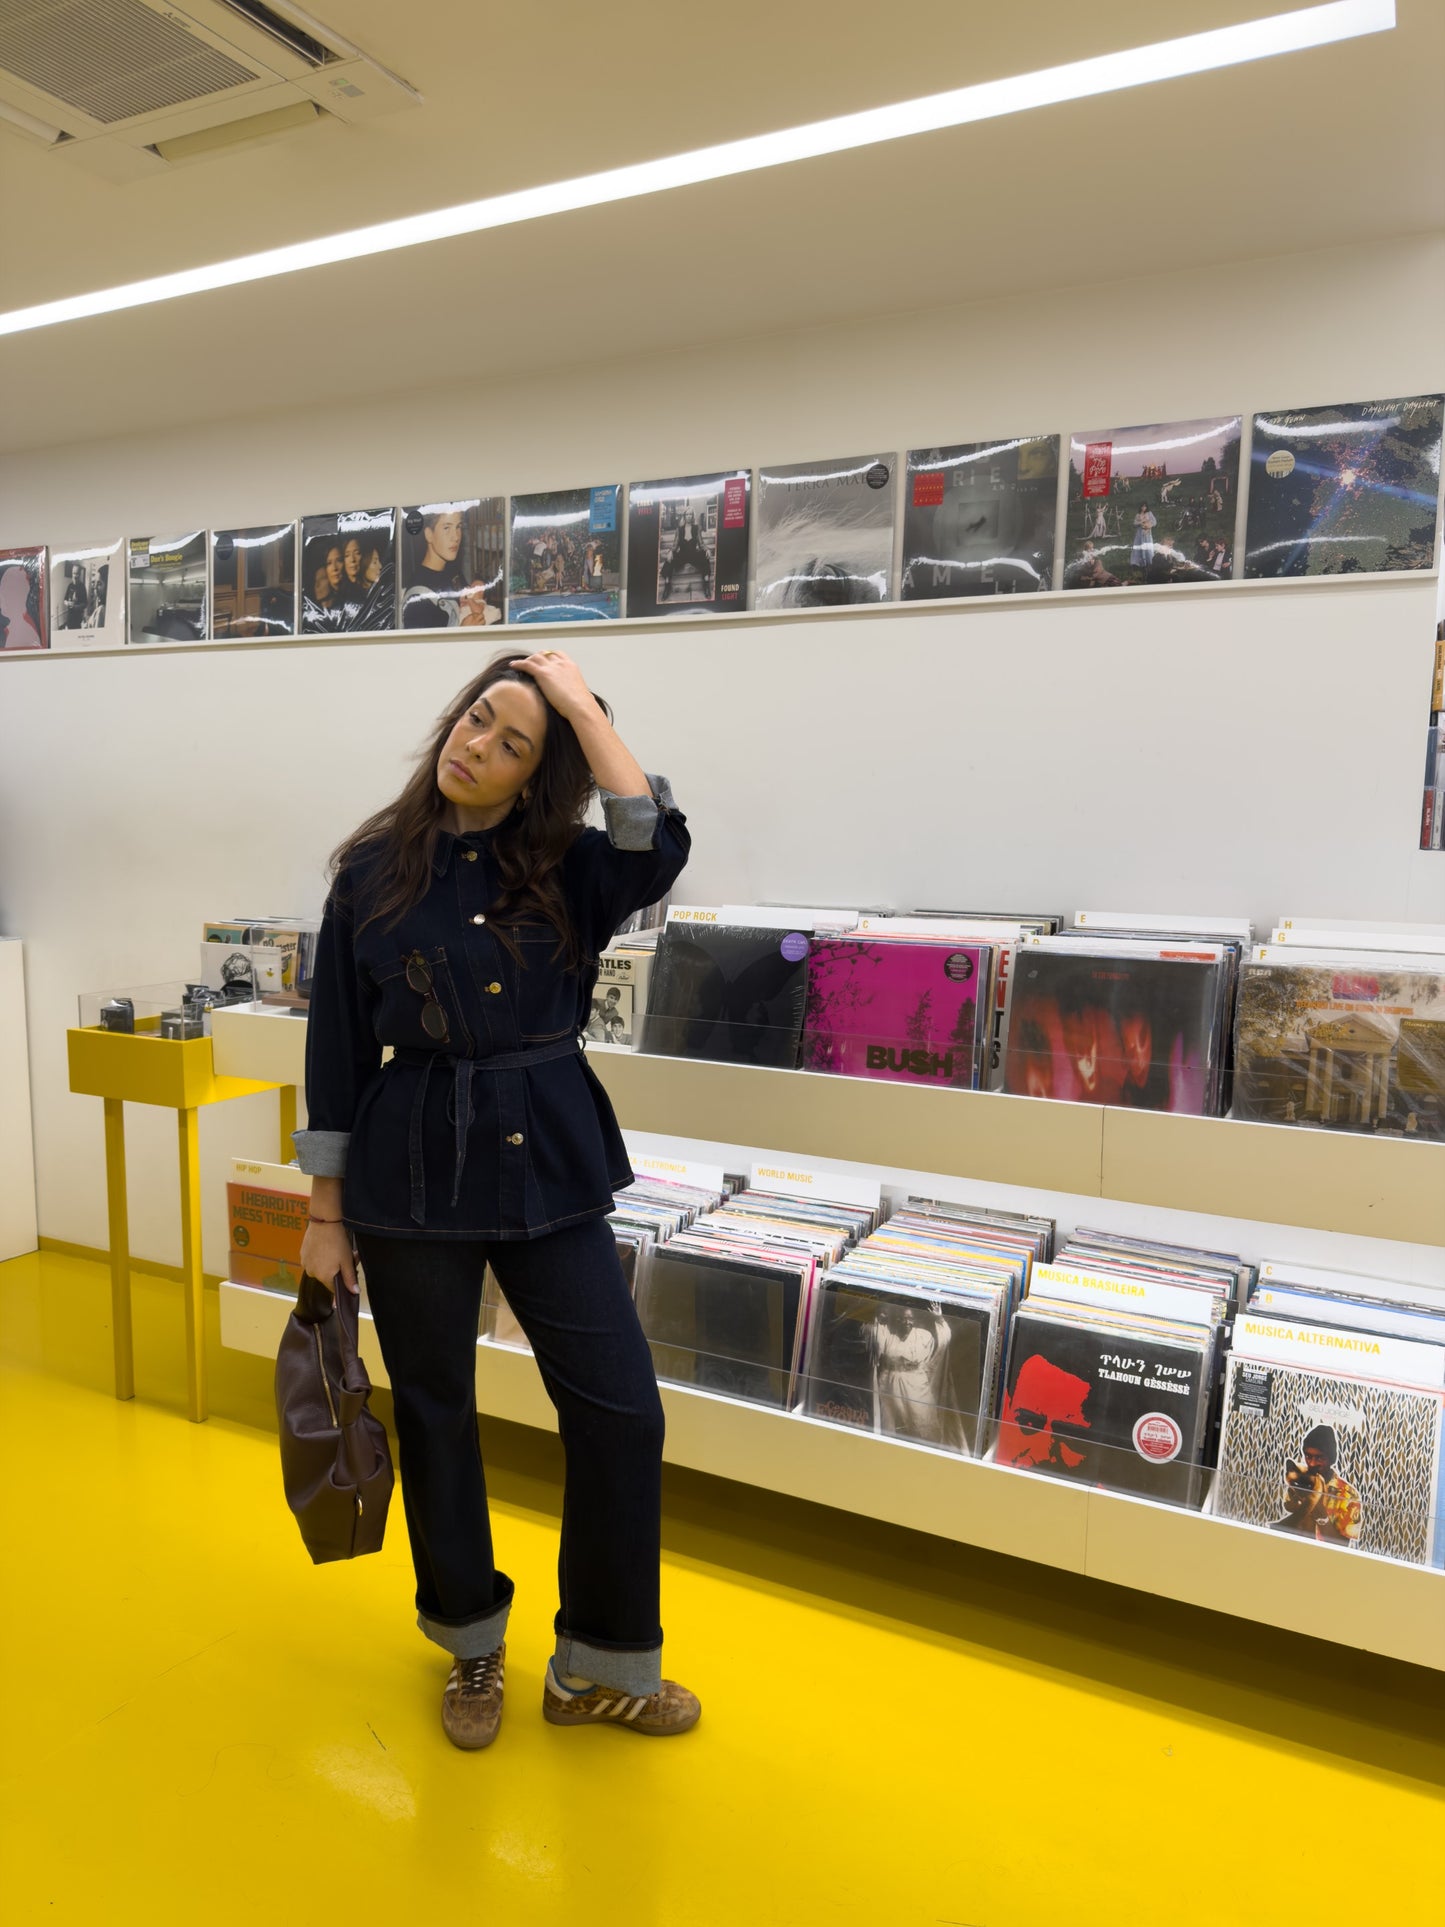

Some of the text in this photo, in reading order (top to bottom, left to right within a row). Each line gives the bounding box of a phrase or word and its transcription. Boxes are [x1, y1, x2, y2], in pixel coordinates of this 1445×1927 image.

[1362, 400, 1439, 419] DAYLIGHT DAYLIGHT
[720, 583, 740, 592] FOUND
[673, 910, 718, 922] POP ROCK
[1080, 914, 1086, 923] E
[862, 920, 869, 929] C
[1284, 920, 1292, 929] H
[1278, 932, 1286, 942] G
[1259, 949, 1267, 960] F
[866, 1045, 953, 1078] BUSH
[236, 1163, 262, 1174] HIP HOP
[757, 1168, 813, 1183] WORLD MUSIC
[244, 1191, 283, 1211] HEARD
[285, 1198, 308, 1215] IT'S
[232, 1205, 263, 1223] MESS
[265, 1212, 302, 1230] THERE
[1266, 1265, 1273, 1276] C
[1038, 1269, 1145, 1296] MUSICA BRASILEIRA
[1265, 1293, 1273, 1304] B
[1245, 1322, 1380, 1354] MUSICA ALTERNATIVA
[1098, 1368, 1142, 1386] TLAHOUN
